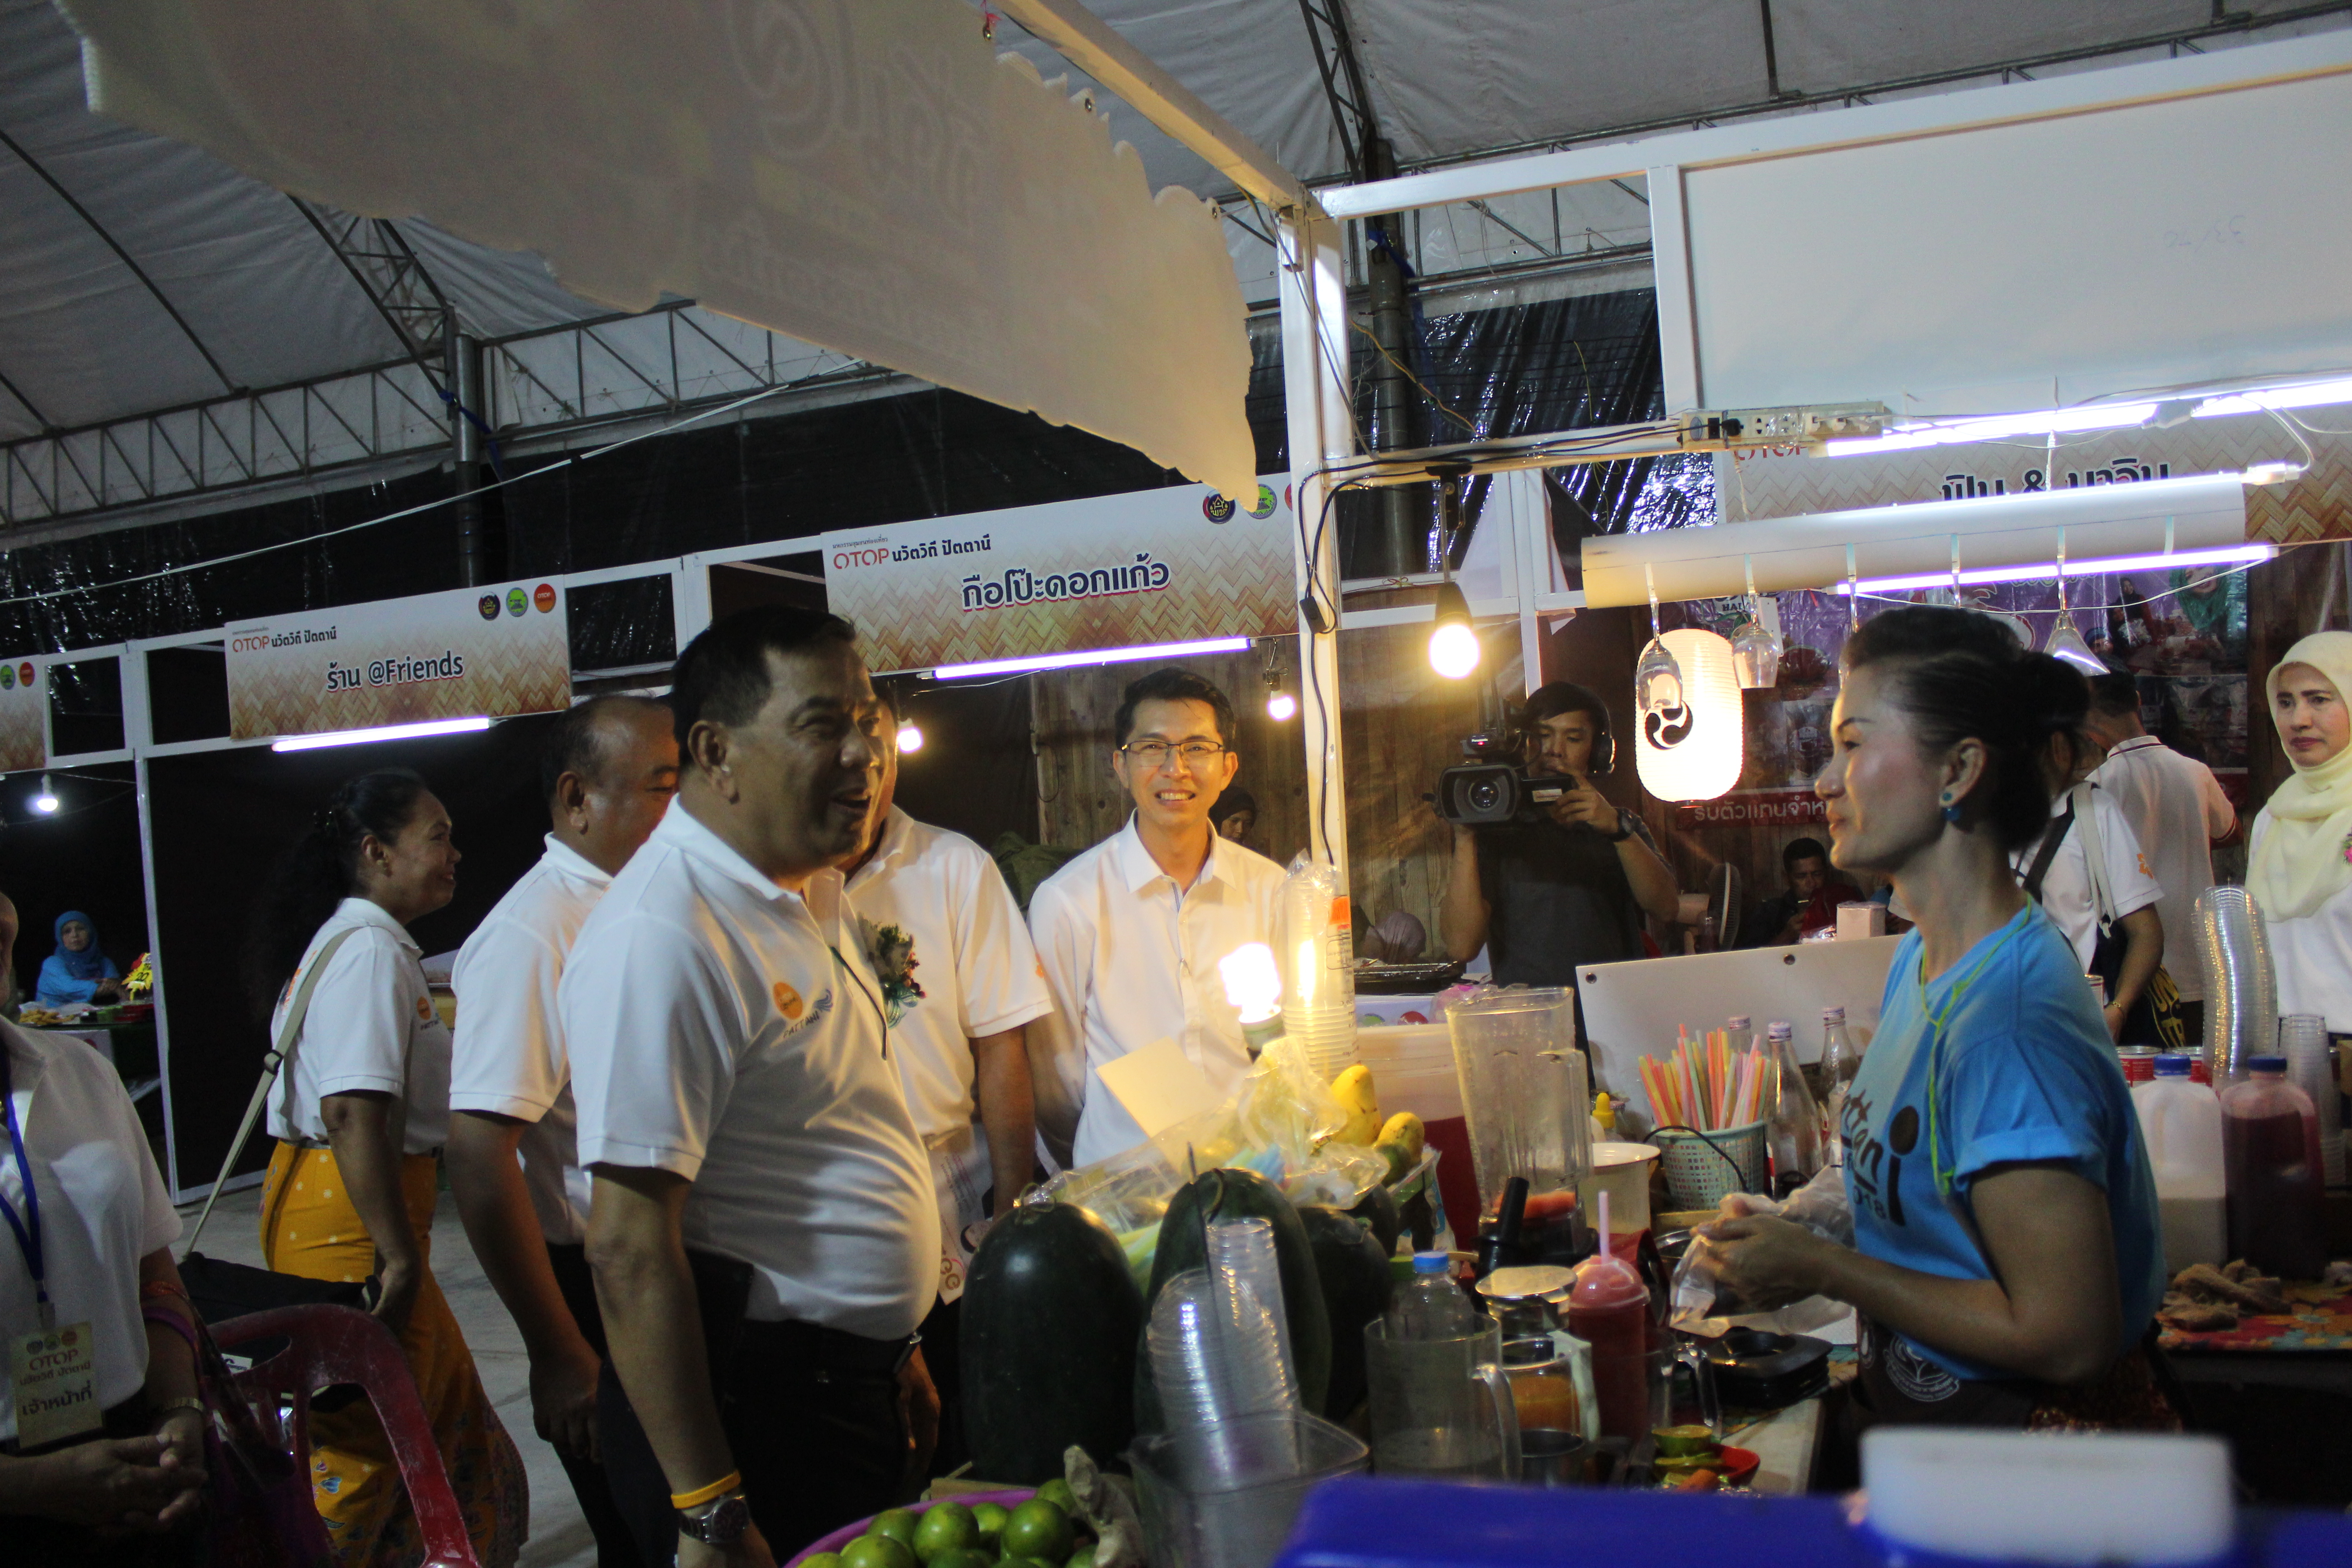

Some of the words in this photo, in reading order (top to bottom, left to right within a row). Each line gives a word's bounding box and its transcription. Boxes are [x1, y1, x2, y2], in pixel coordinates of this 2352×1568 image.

[833, 548, 889, 569] OTOP
[892, 541, 938, 562] นวัตวิถี
[942, 534, 991, 555] ปัตตานี
[963, 553, 1169, 607] กือโป๊ะดอกแก้ว
[232, 636, 270, 652] OTOP
[304, 626, 337, 643] ปัตตานี
[327, 662, 361, 689] ร้าน
[368, 650, 463, 684] @Friends
[29, 1348, 78, 1371] OTOP
